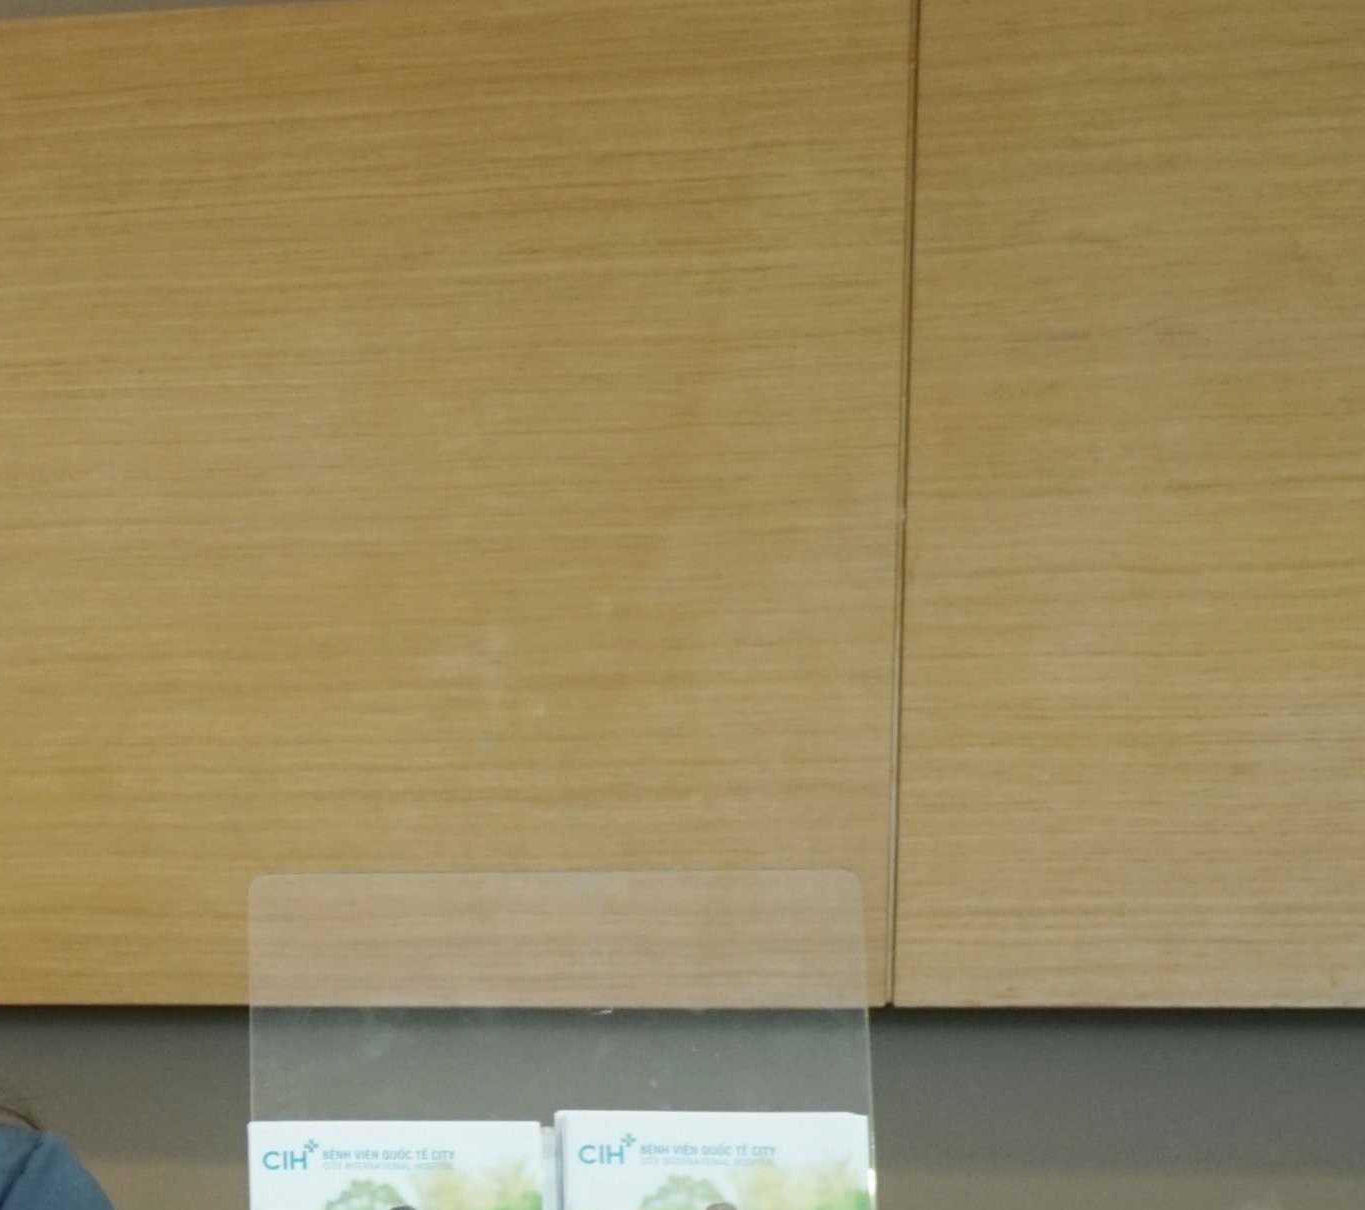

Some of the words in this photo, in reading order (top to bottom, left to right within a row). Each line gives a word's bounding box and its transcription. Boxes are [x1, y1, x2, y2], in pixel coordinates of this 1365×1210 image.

[431, 1149, 456, 1161] CITY
[578, 1144, 625, 1165] CIH
[751, 1145, 777, 1157] CITY
[262, 1150, 308, 1171] CIH
